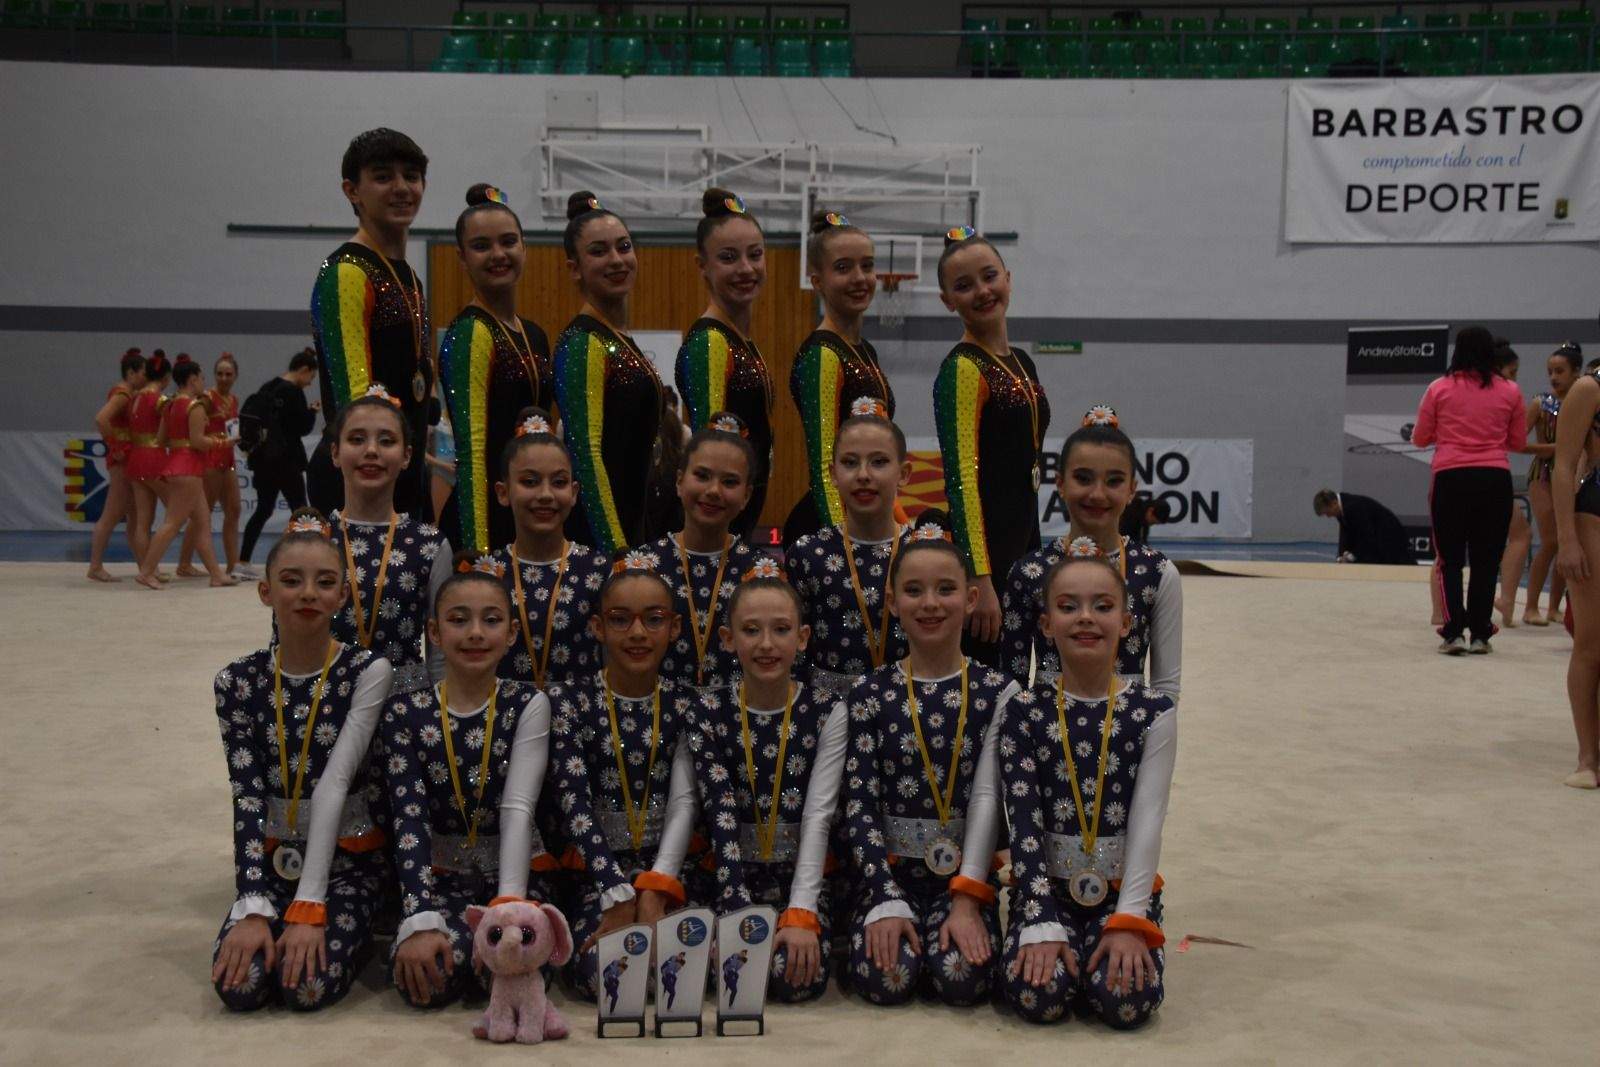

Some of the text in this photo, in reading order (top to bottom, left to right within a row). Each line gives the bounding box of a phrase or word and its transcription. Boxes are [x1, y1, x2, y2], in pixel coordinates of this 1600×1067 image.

[1311, 104, 1583, 137] BARBASTRO
[1363, 144, 1525, 173] comprometido con el
[1345, 183, 1540, 212] DEPORTE
